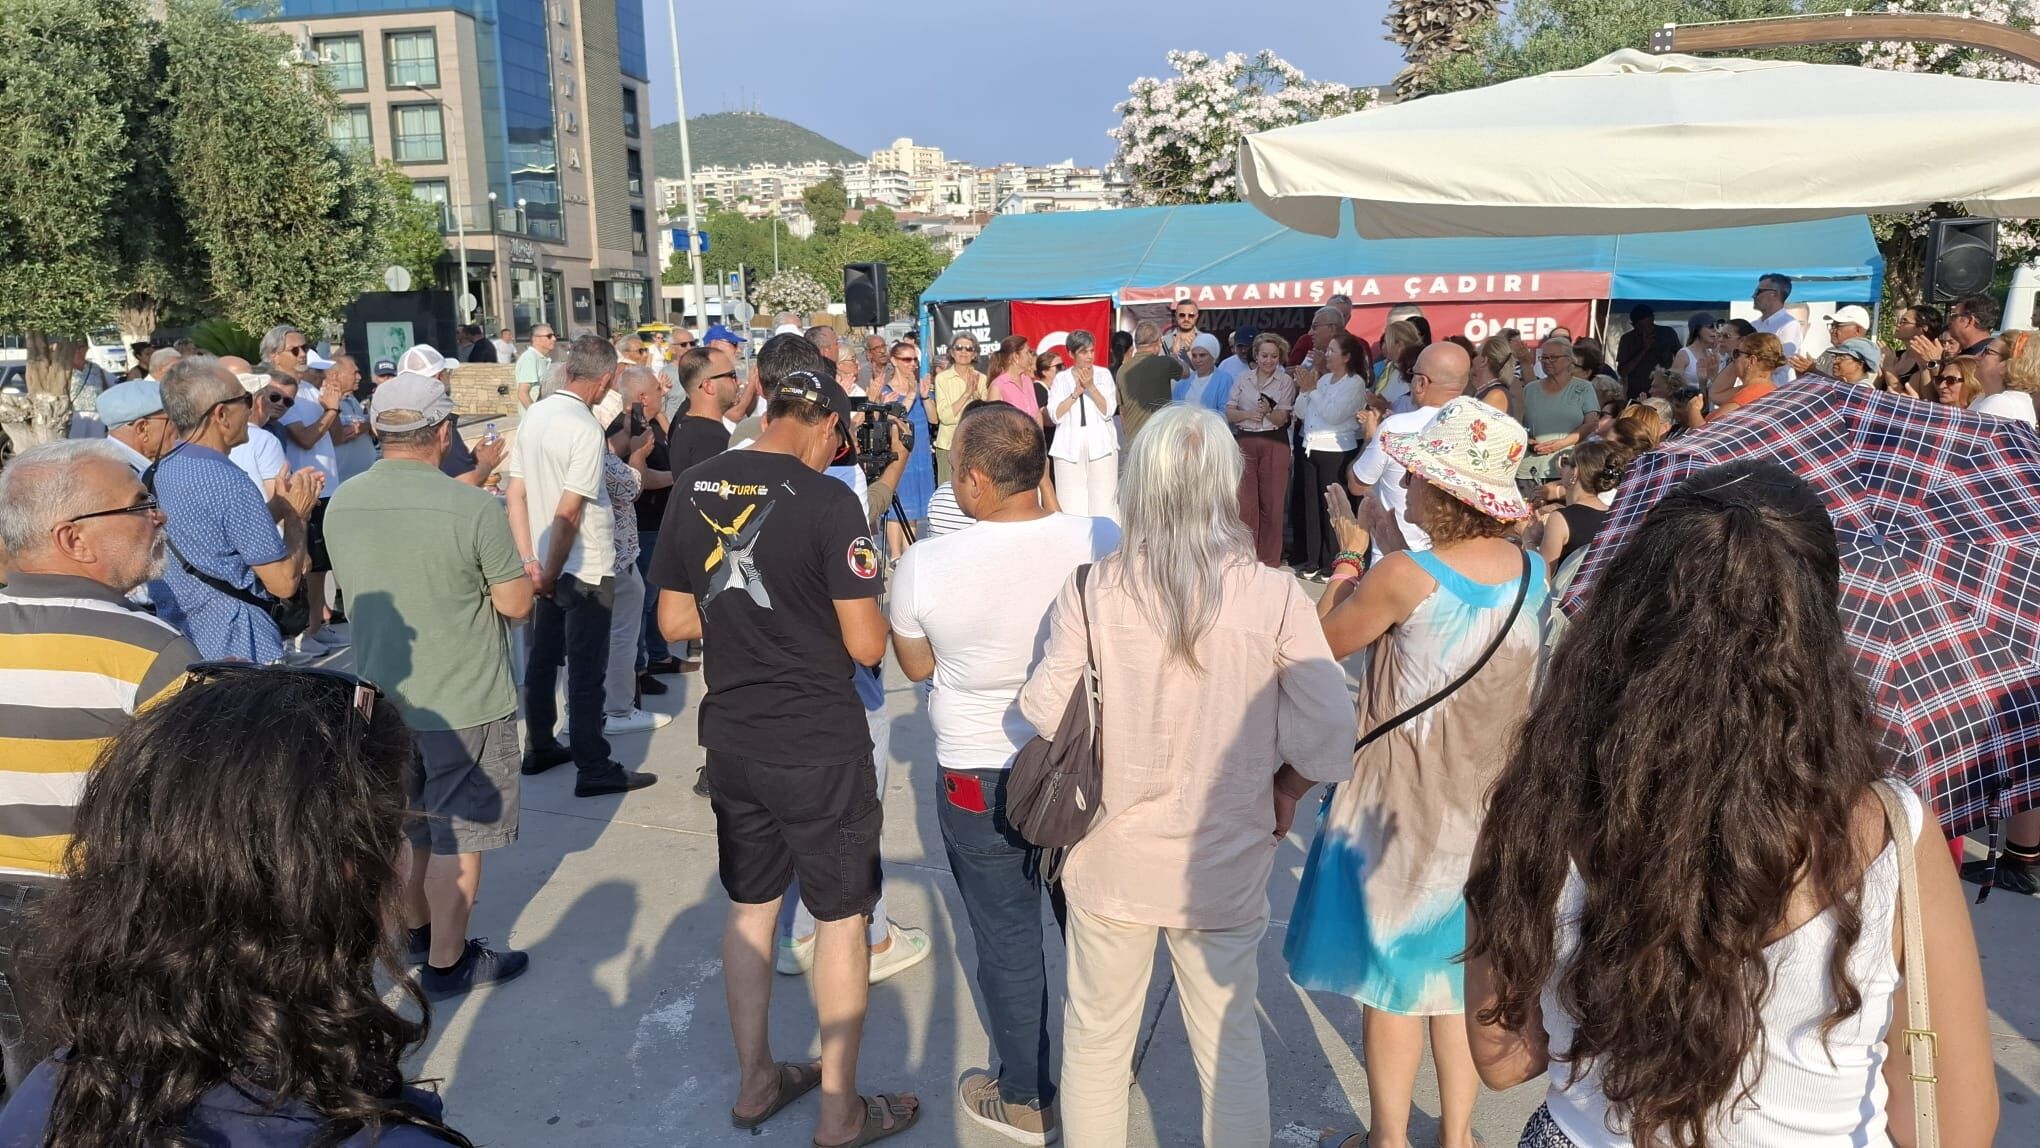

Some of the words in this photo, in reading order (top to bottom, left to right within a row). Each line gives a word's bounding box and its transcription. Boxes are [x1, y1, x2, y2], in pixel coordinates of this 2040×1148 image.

[1175, 278, 1380, 302] DAYANIŞMA
[1404, 274, 1539, 298] ÇADIRI
[953, 308, 990, 328] ASLA
[1464, 312, 1557, 342] ÖMER
[693, 481, 720, 492] SOLO
